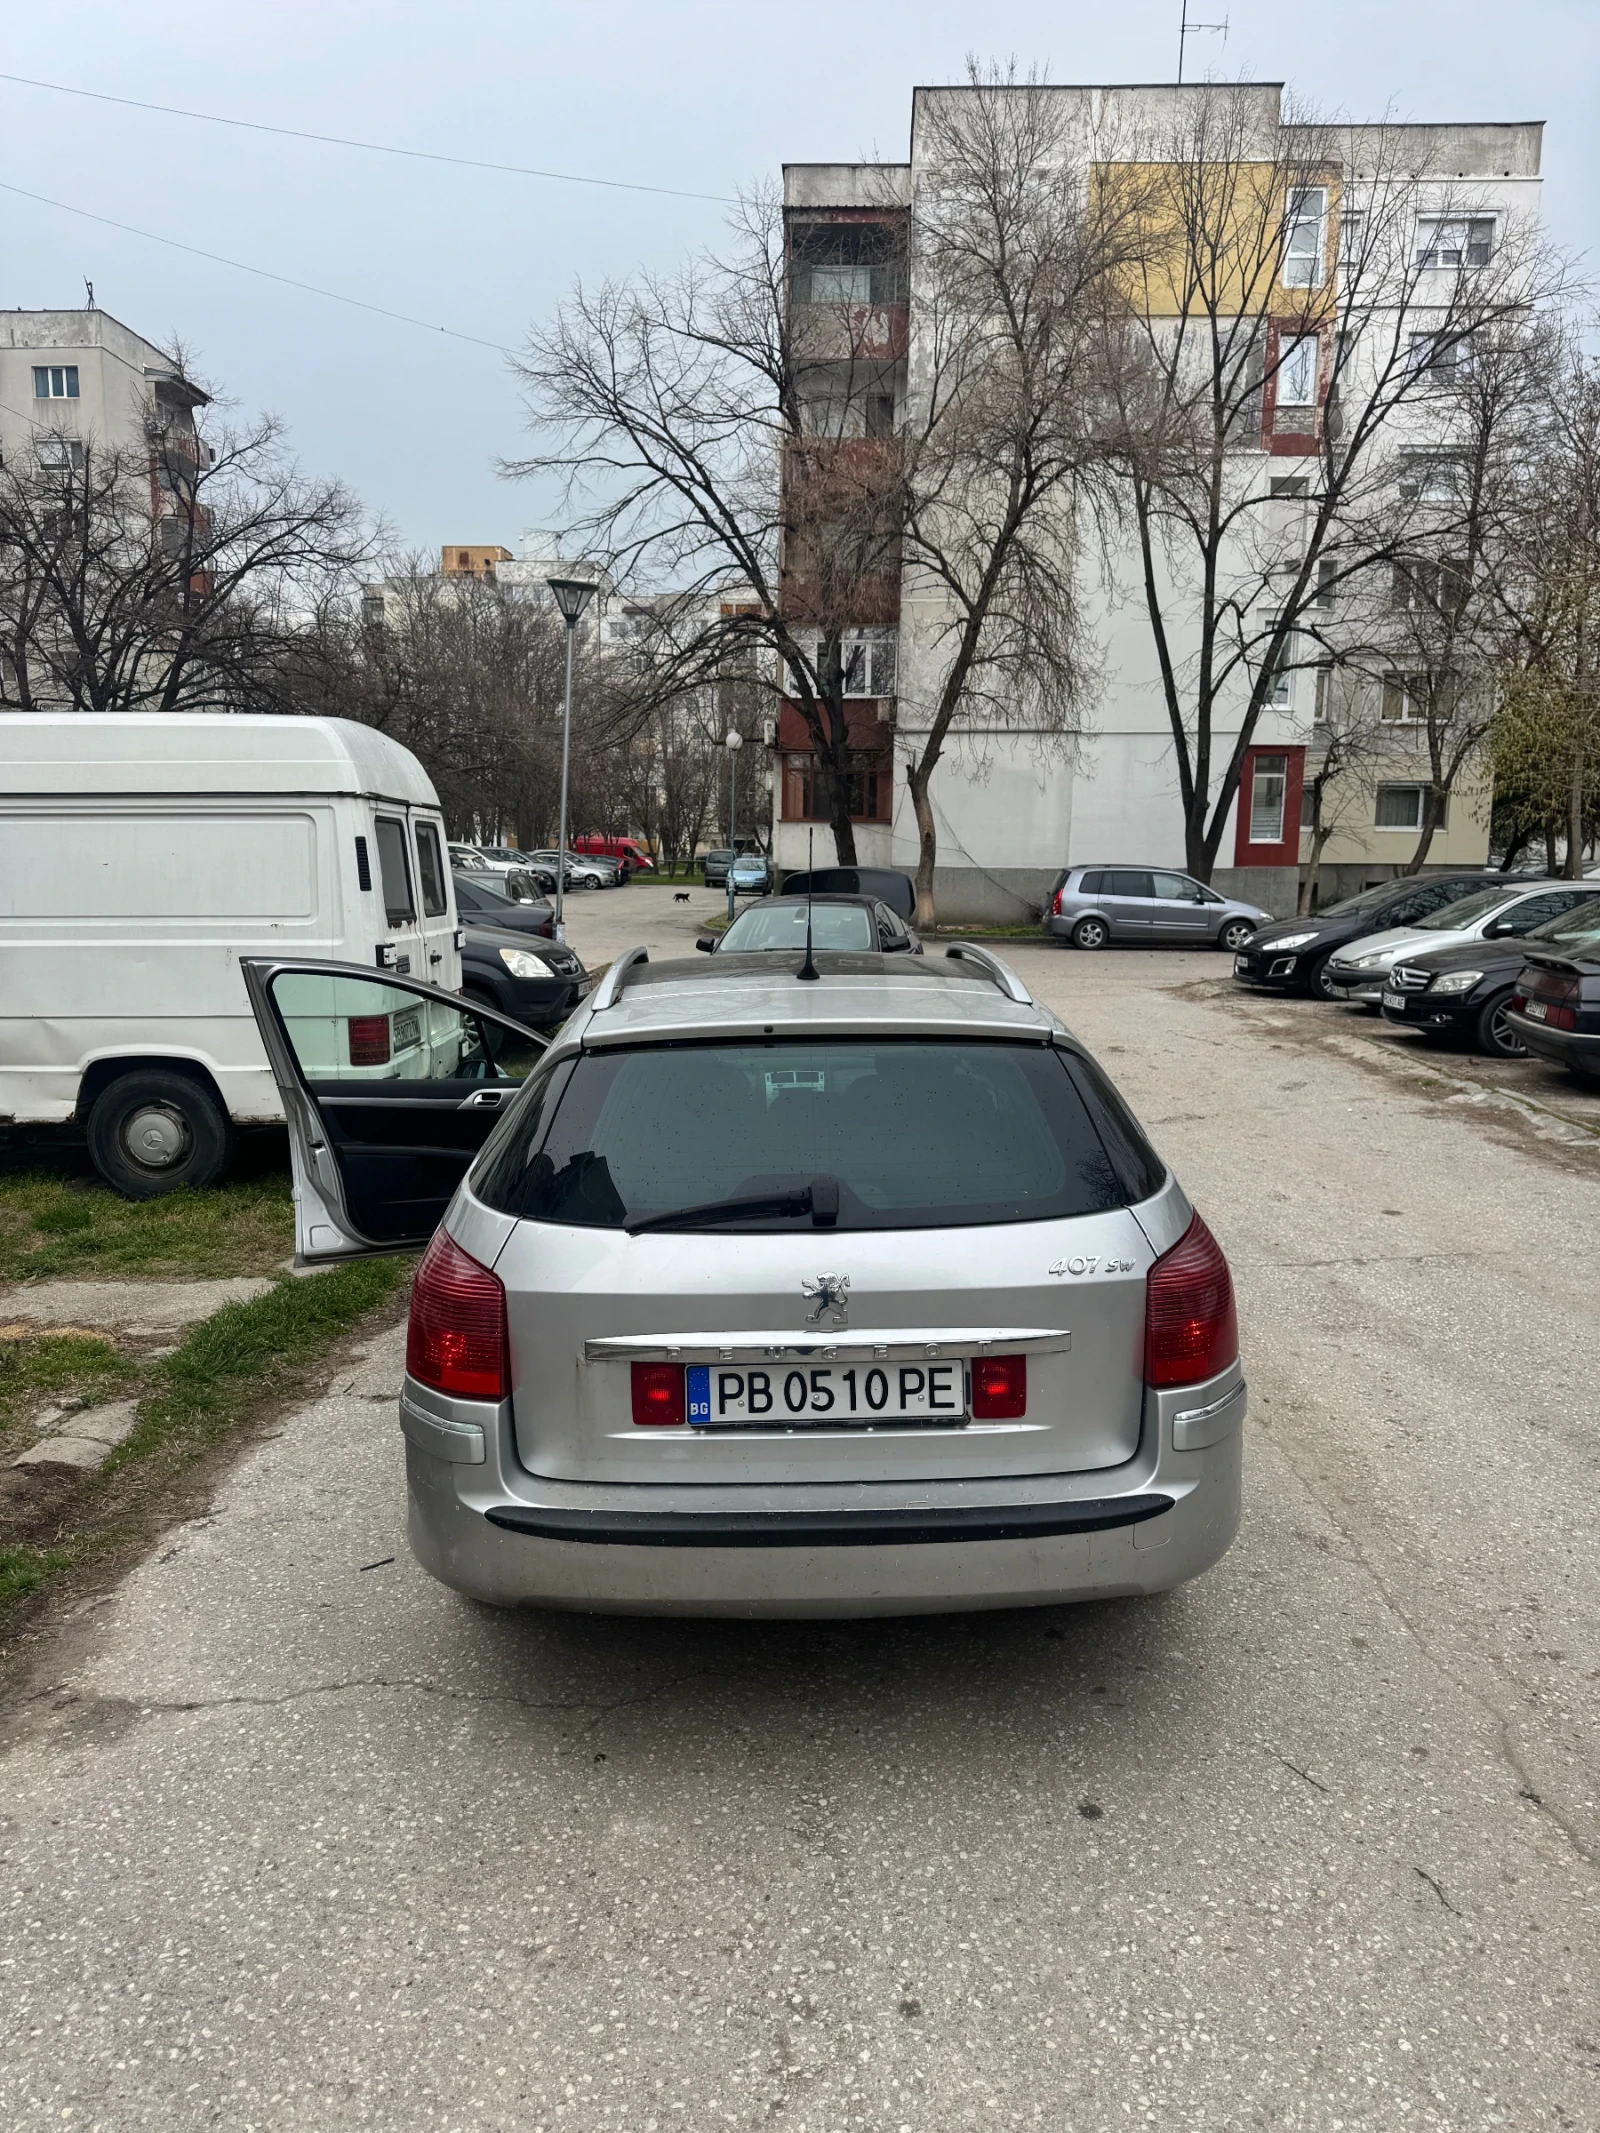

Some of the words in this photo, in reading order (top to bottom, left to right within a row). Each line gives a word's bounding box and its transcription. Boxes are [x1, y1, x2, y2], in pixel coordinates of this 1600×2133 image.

[1049, 1256, 1101, 1276] 407
[1104, 1259, 1136, 1273] SW
[667, 1341, 991, 1360] PEUGEOT
[718, 1372, 773, 1414] PB
[784, 1368, 889, 1412] 0510
[899, 1367, 955, 1409] PE
[690, 1402, 708, 1415] BG
